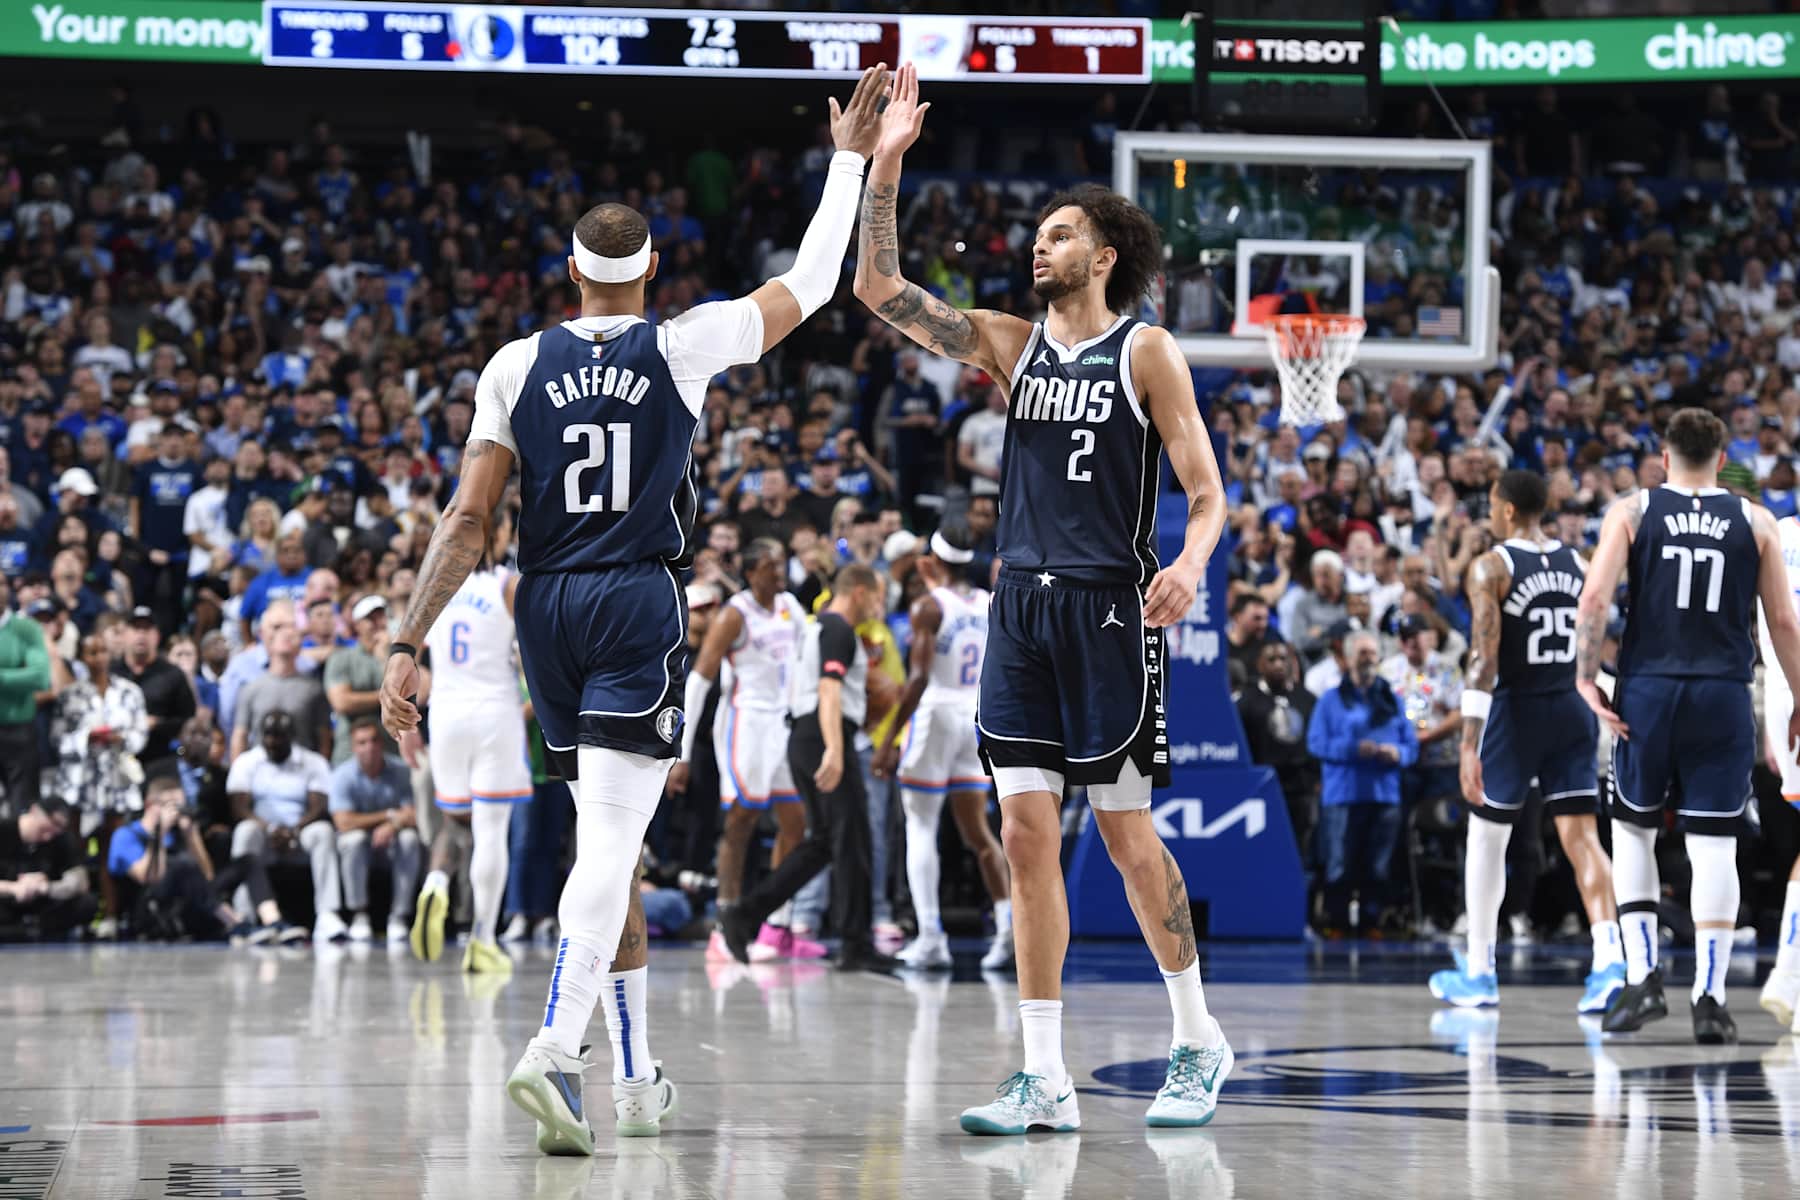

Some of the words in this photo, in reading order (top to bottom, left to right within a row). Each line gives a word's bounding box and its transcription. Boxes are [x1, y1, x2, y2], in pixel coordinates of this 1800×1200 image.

[32, 3, 128, 44] Your
[134, 16, 264, 57] money
[311, 29, 333, 57] 2
[561, 35, 620, 65] 104
[1256, 39, 1364, 64] TISSOT
[1644, 22, 1787, 70] chime
[809, 40, 860, 70] 101
[1085, 46, 1100, 74] 1
[1404, 33, 1467, 71] the
[1474, 32, 1596, 76] hoops
[1081, 354, 1114, 366] chime
[545, 366, 651, 409] GAFFORD
[1015, 374, 1116, 423] MAVS
[562, 422, 632, 513] 21
[1067, 428, 1096, 482] 2
[1503, 570, 1584, 617] WASHINGTON
[1661, 544, 1725, 613] 77
[449, 619, 471, 666] 6
[1527, 606, 1577, 665] 25
[960, 643, 979, 687] 2
[1201, 741, 1239, 761] Pixel
